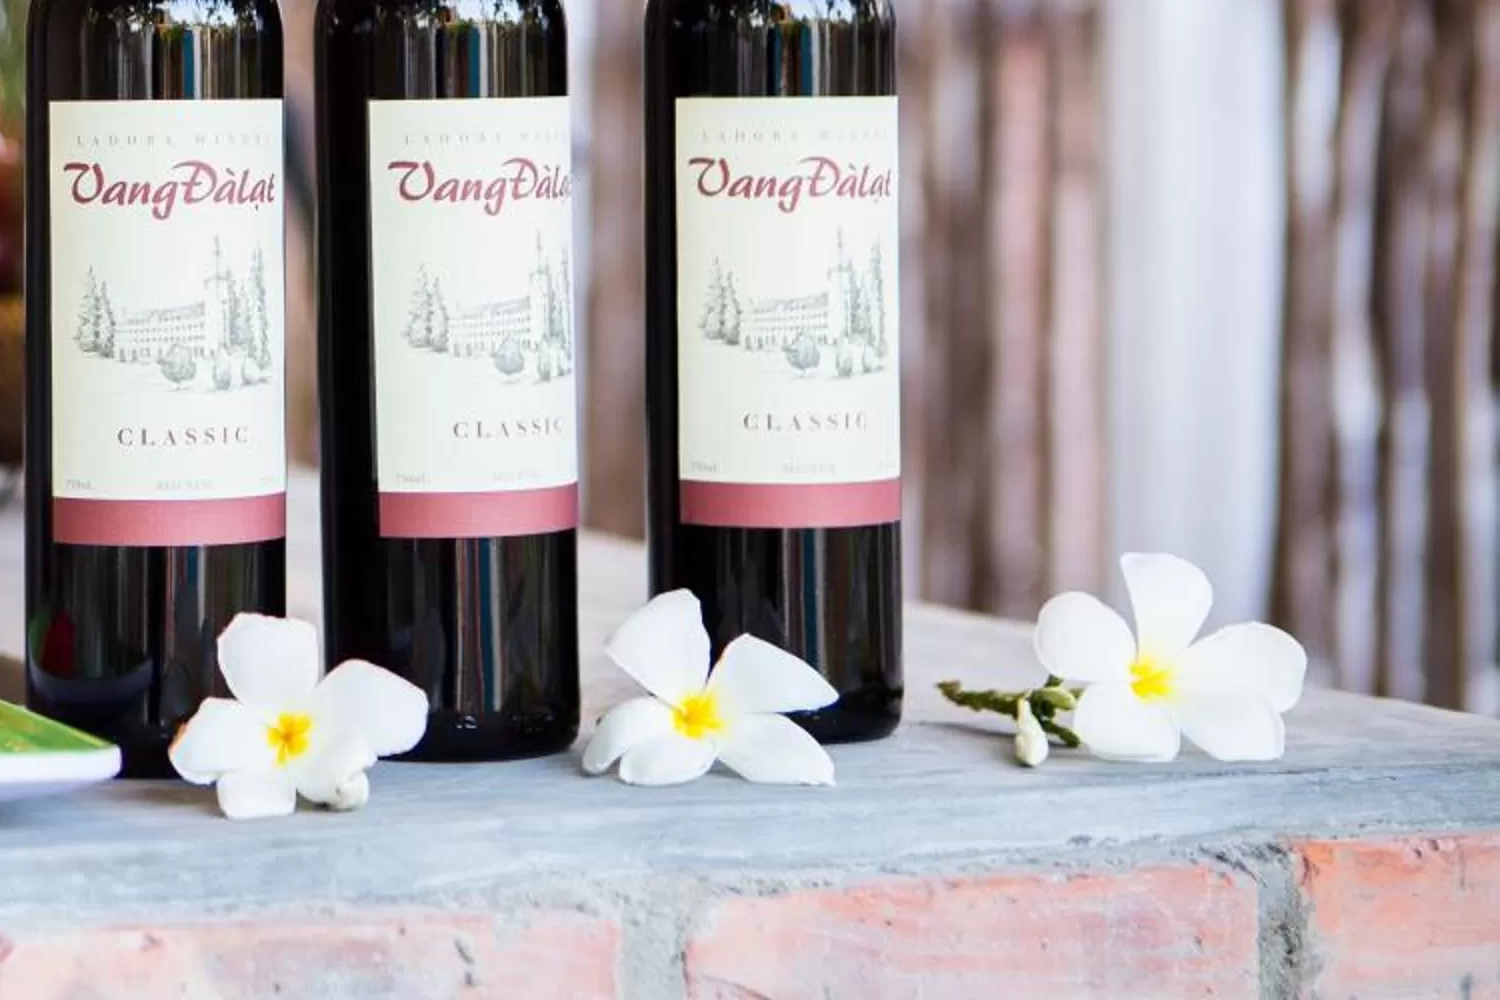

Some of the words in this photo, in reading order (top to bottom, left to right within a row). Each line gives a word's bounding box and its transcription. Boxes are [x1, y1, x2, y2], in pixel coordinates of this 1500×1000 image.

[453, 419, 564, 440] CLASSIC
[743, 411, 868, 433] CLASSIC
[117, 425, 249, 447] CLASSIC
